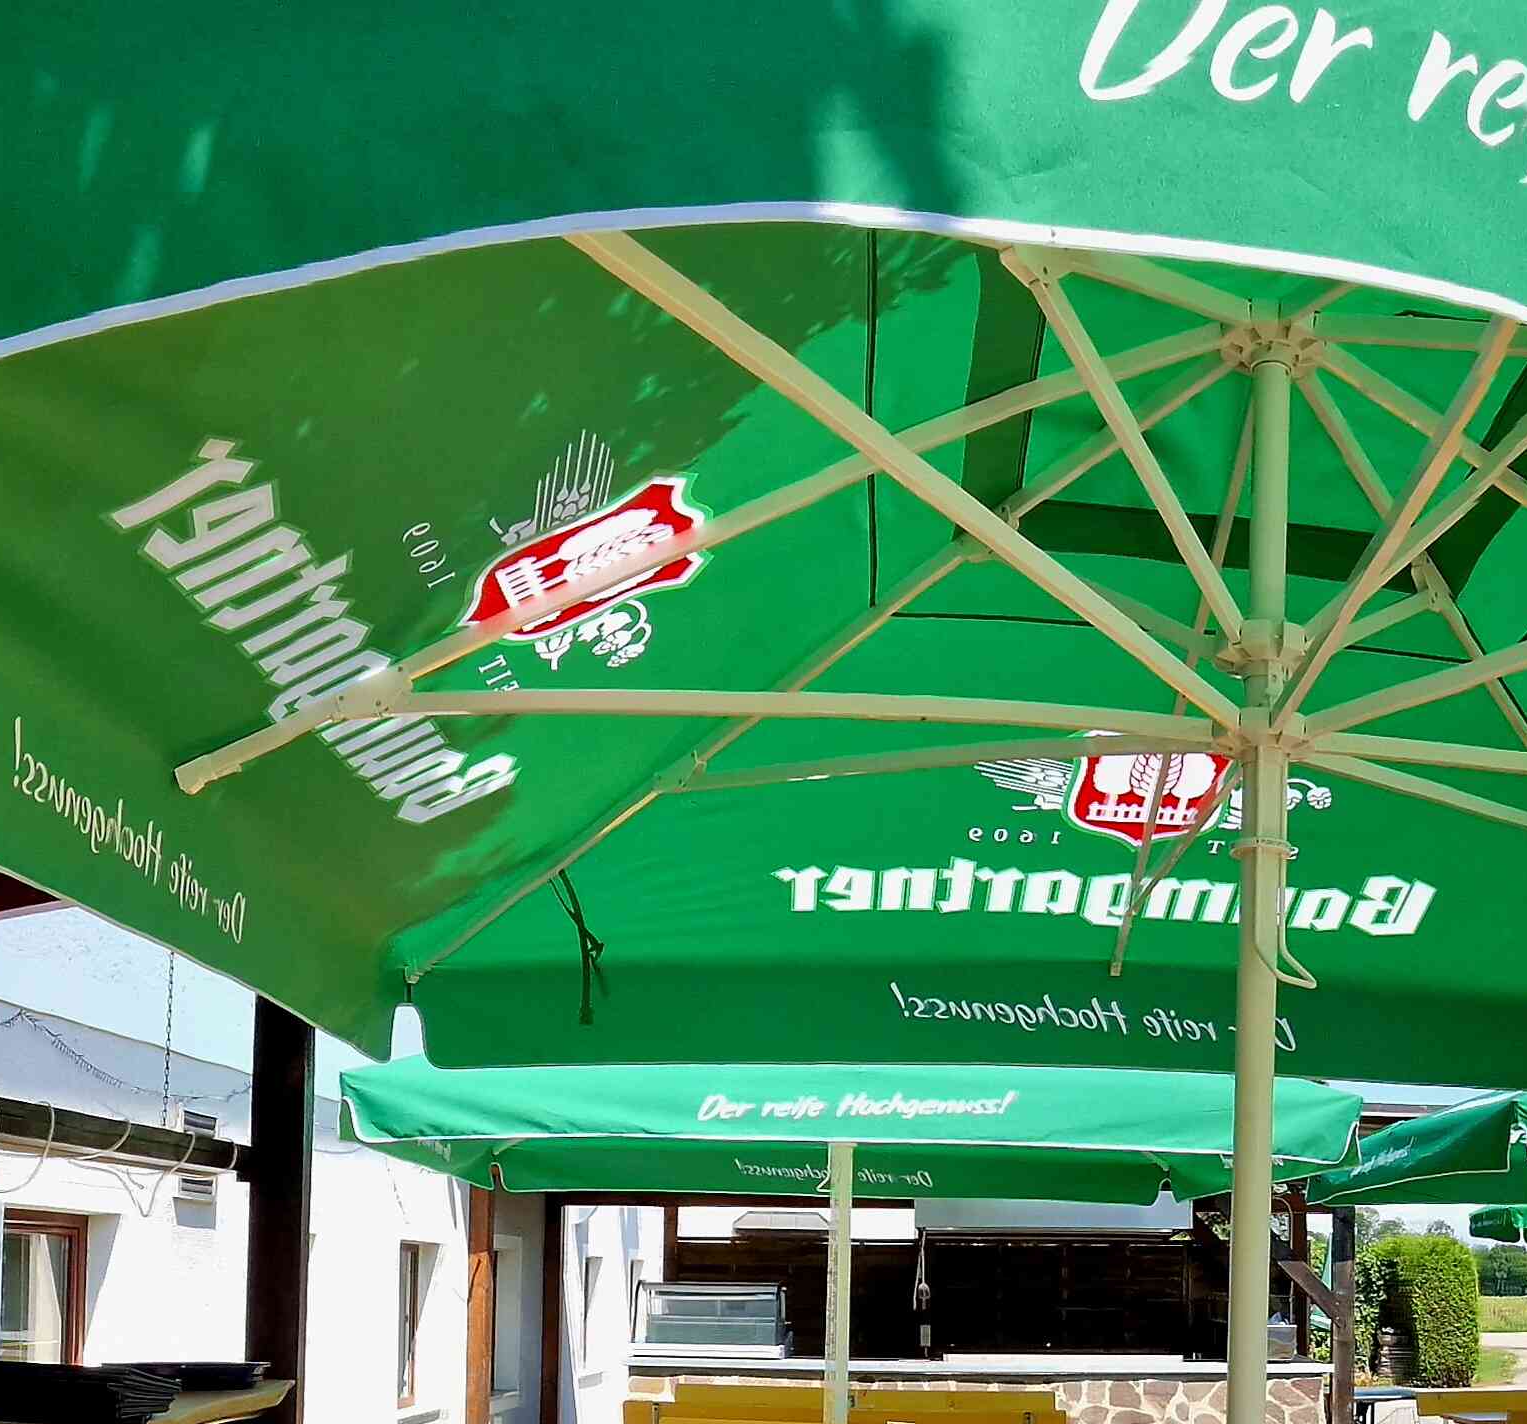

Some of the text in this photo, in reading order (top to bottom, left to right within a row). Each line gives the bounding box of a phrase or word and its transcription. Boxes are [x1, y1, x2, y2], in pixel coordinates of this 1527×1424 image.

[1079, 0, 1372, 104] Der
[697, 1089, 1021, 1121] Der reife Hochgenuss!
